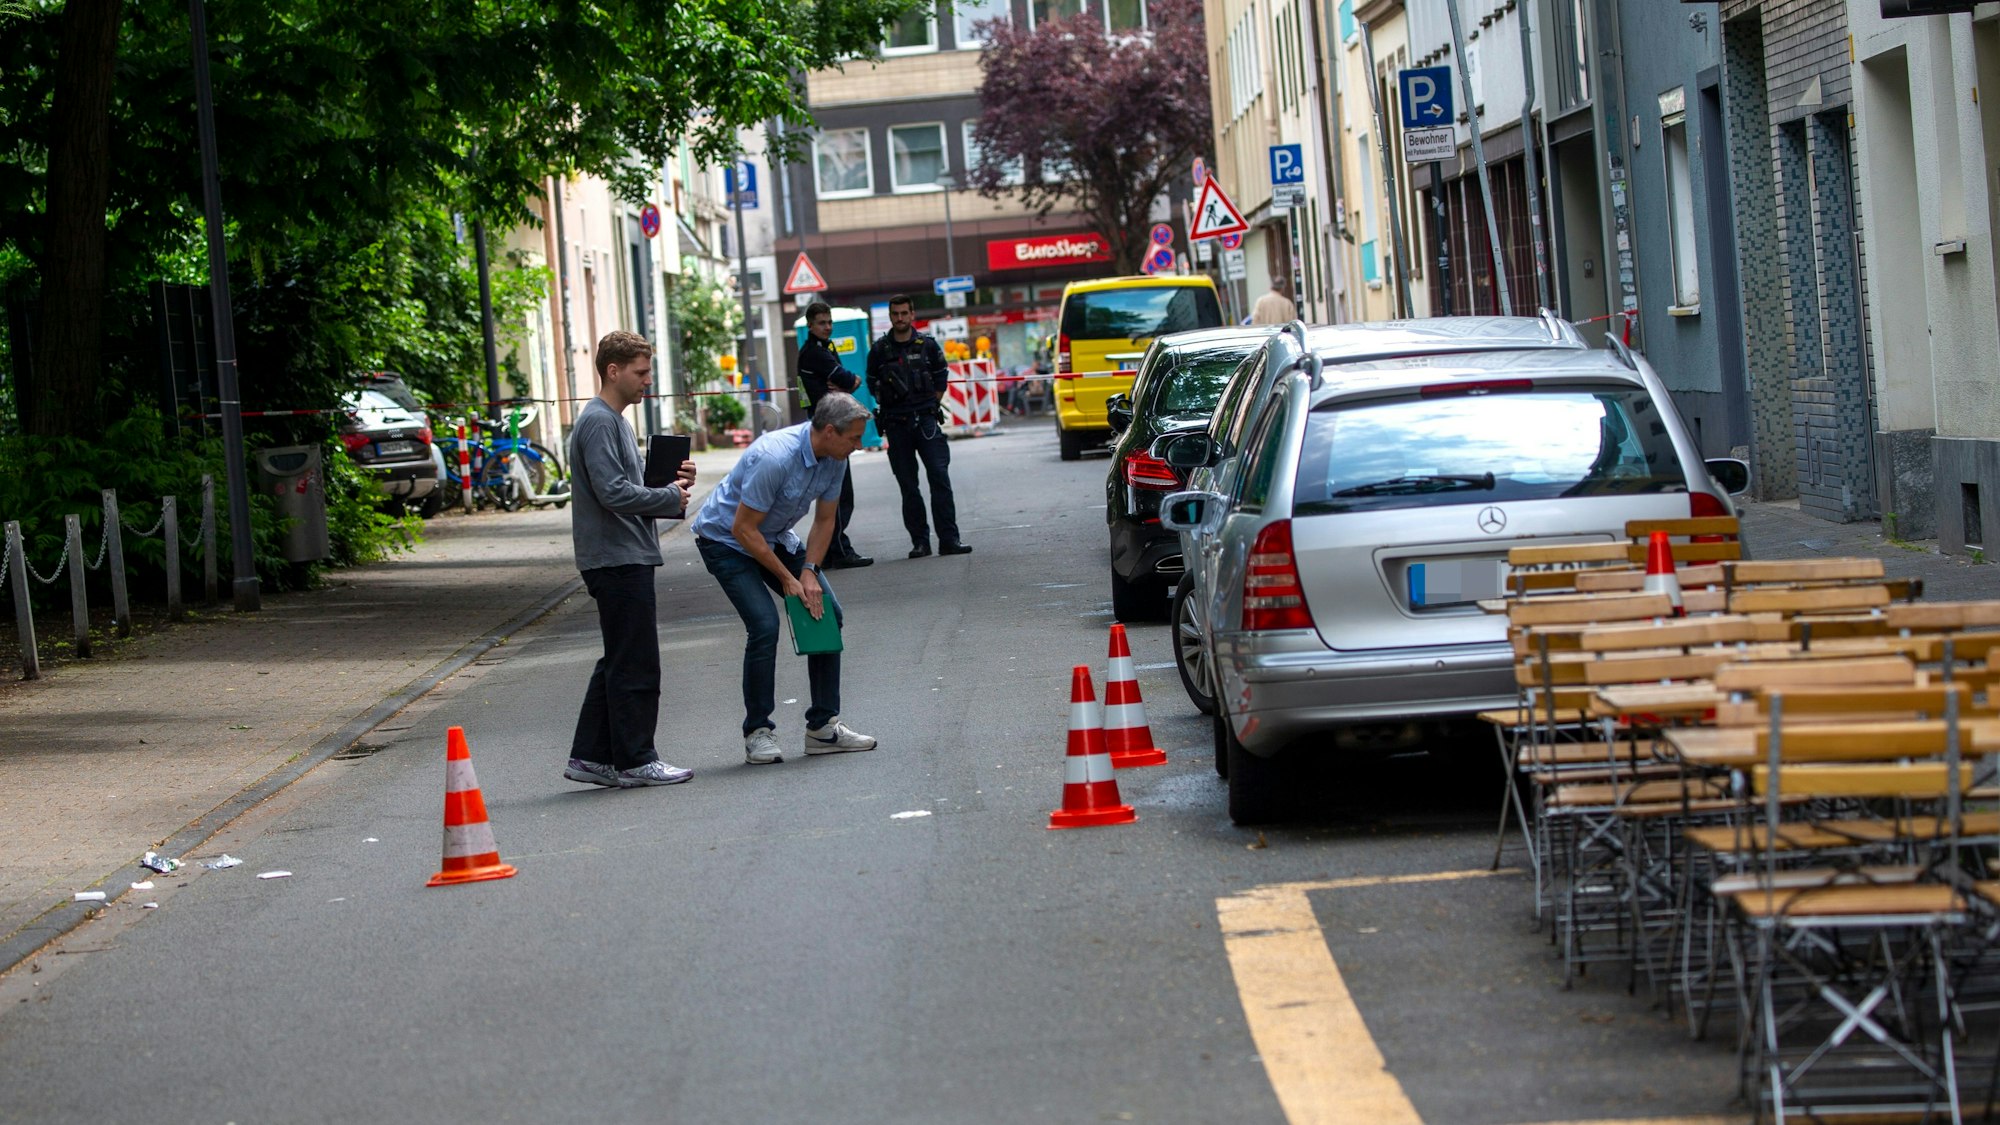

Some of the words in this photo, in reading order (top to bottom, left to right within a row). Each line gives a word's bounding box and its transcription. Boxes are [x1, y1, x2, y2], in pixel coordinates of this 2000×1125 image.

[1408, 76, 1436, 120] P
[1408, 133, 1448, 146] Bewohner
[1275, 150, 1293, 180] P
[1015, 239, 1098, 260] EuroShop
